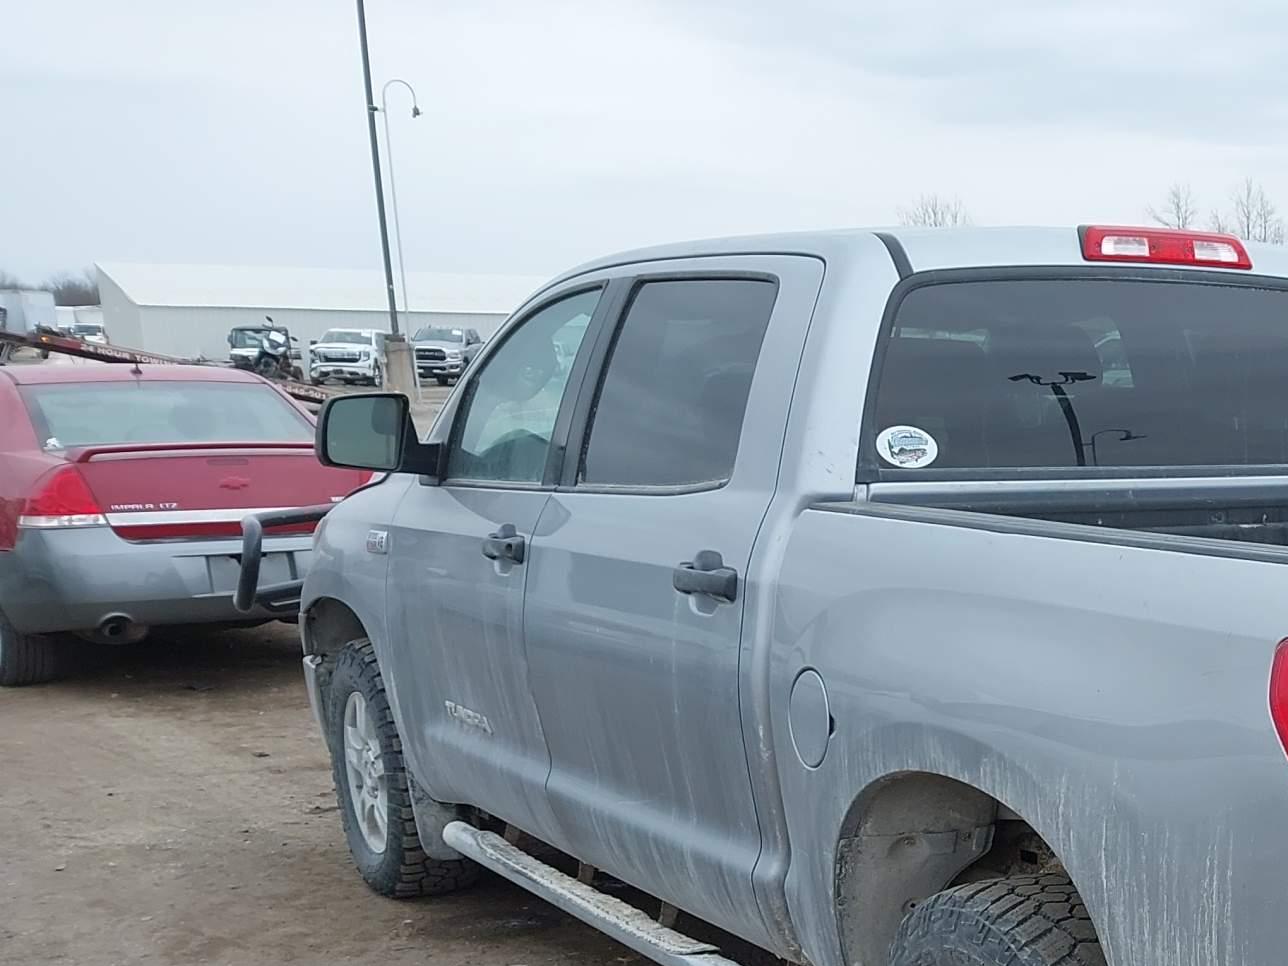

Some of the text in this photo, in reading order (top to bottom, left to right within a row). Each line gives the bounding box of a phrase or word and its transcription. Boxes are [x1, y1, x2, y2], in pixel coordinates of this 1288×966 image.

[97, 347, 130, 360] HOUR
[110, 502, 155, 511] IMPALA
[444, 699, 494, 735] TUNDRA
